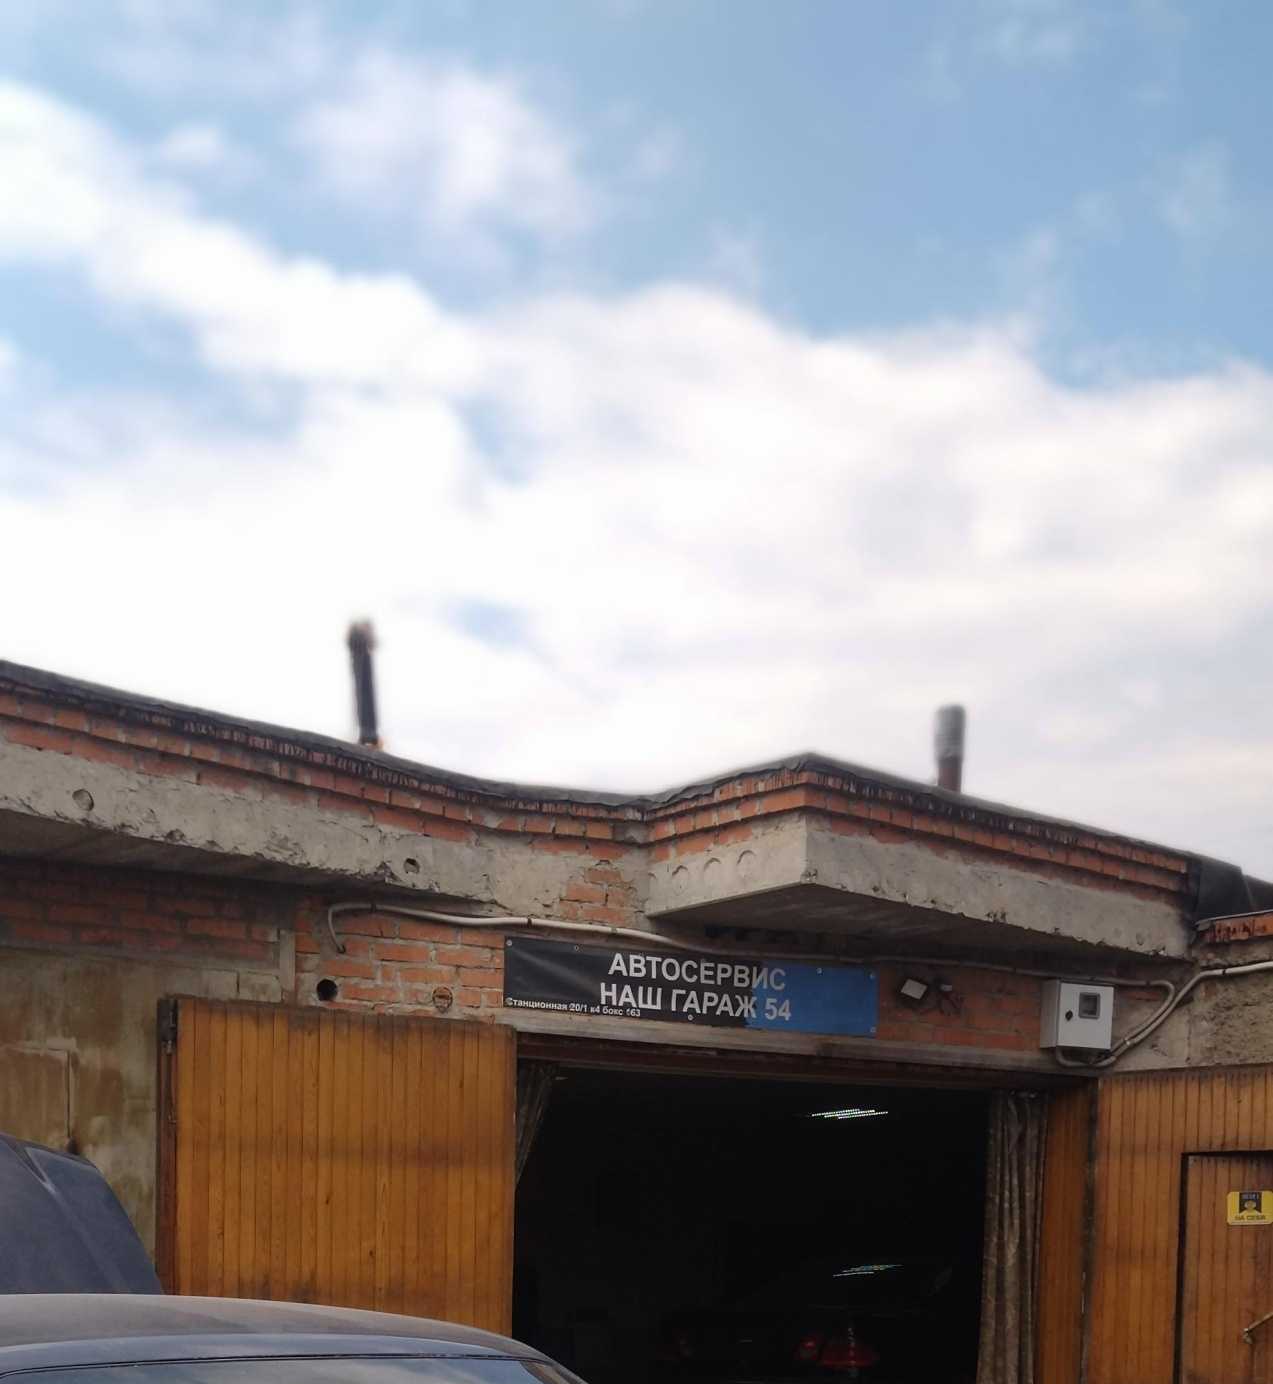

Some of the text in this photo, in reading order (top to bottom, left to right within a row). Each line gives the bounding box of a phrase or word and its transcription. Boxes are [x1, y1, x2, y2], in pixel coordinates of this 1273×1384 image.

[608, 952, 786, 991] АВТОСЕРВИС
[506, 997, 568, 1010] Станционная
[603, 1006, 623, 1016] бокс
[600, 982, 791, 1021] НАШ ГАРАЖ 54
